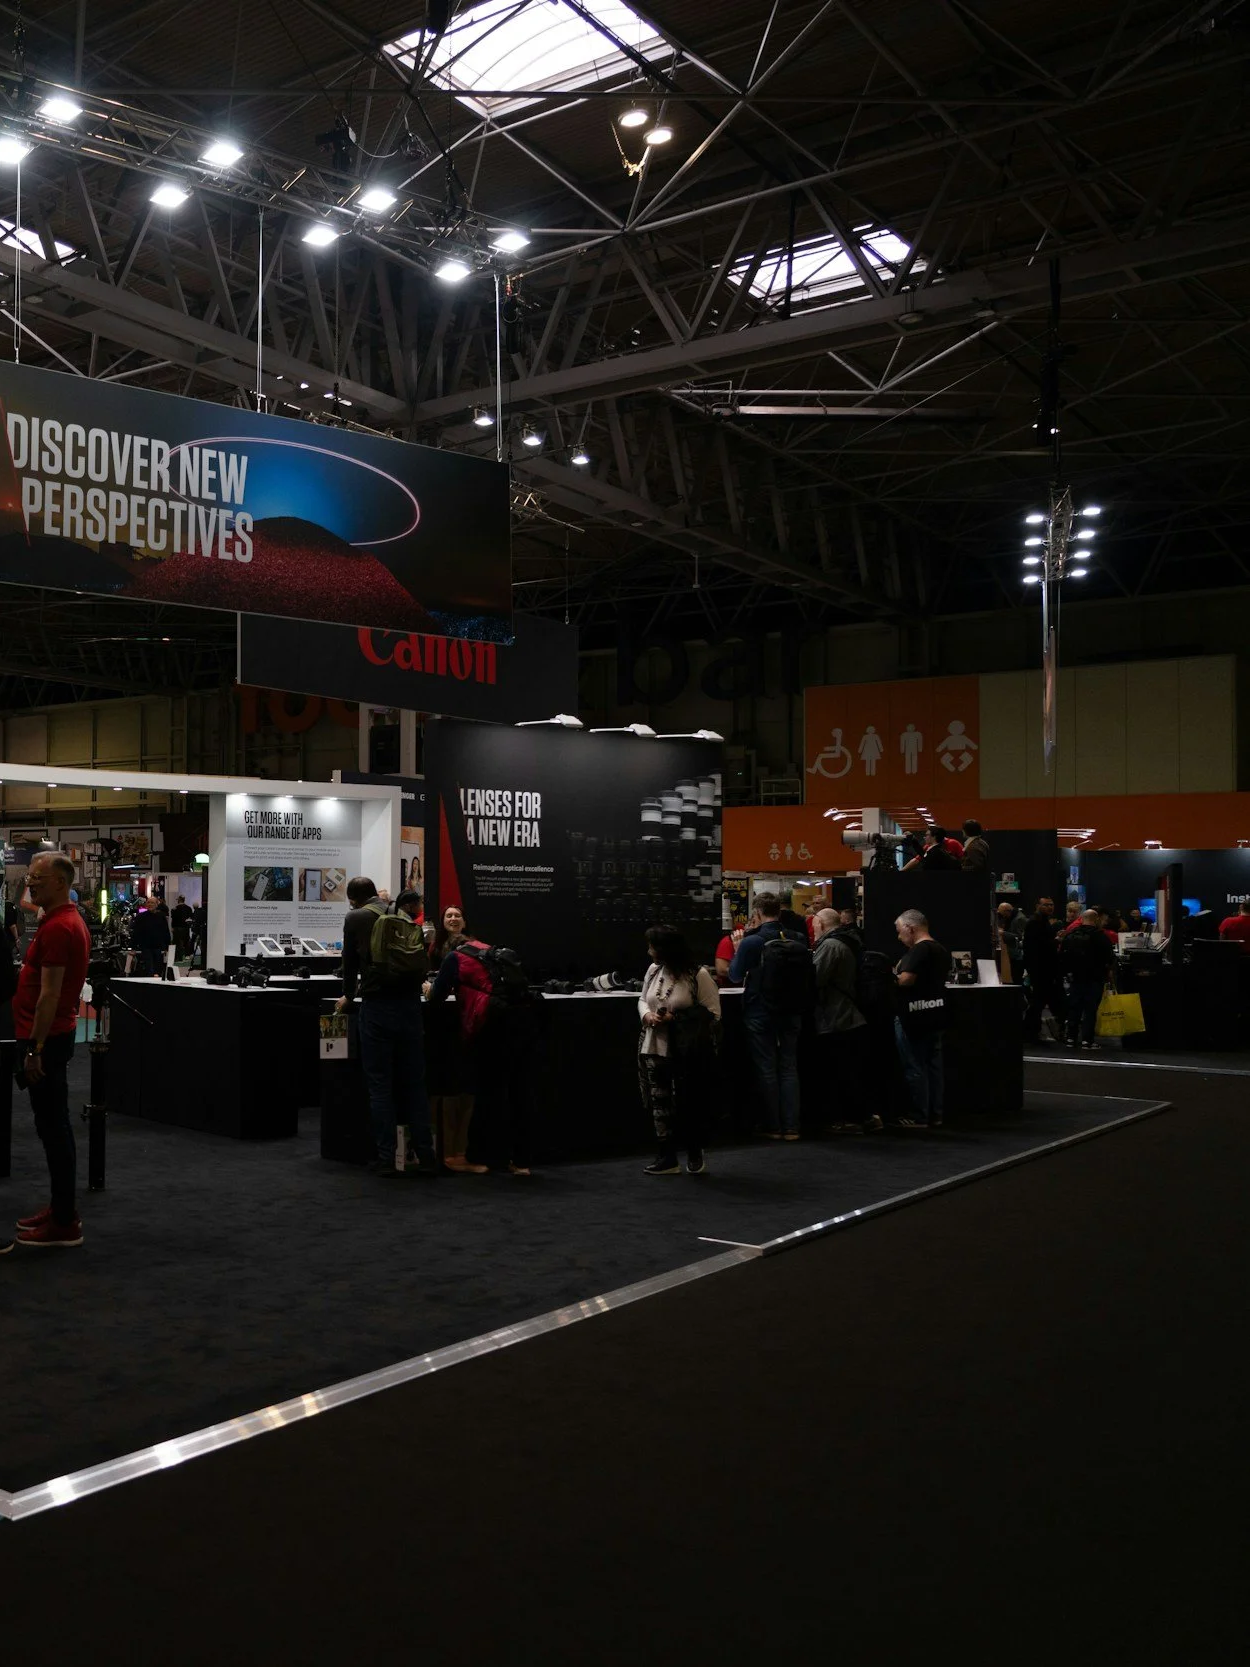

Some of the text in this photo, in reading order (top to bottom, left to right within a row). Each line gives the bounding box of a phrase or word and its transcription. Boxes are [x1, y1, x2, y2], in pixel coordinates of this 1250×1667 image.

[6, 411, 249, 506] DISCOVER NEW
[21, 477, 254, 565] PERSPECTIVES
[357, 626, 497, 685] Canon
[244, 810, 303, 826] GET MORE WITH
[460, 788, 541, 818] LENSES FOR
[247, 825, 322, 841] OUR RANGE OF APPS
[466, 818, 541, 848] A NEW ERA
[473, 863, 554, 873] Reimagine optical excellence
[908, 998, 945, 1013] Nikon
